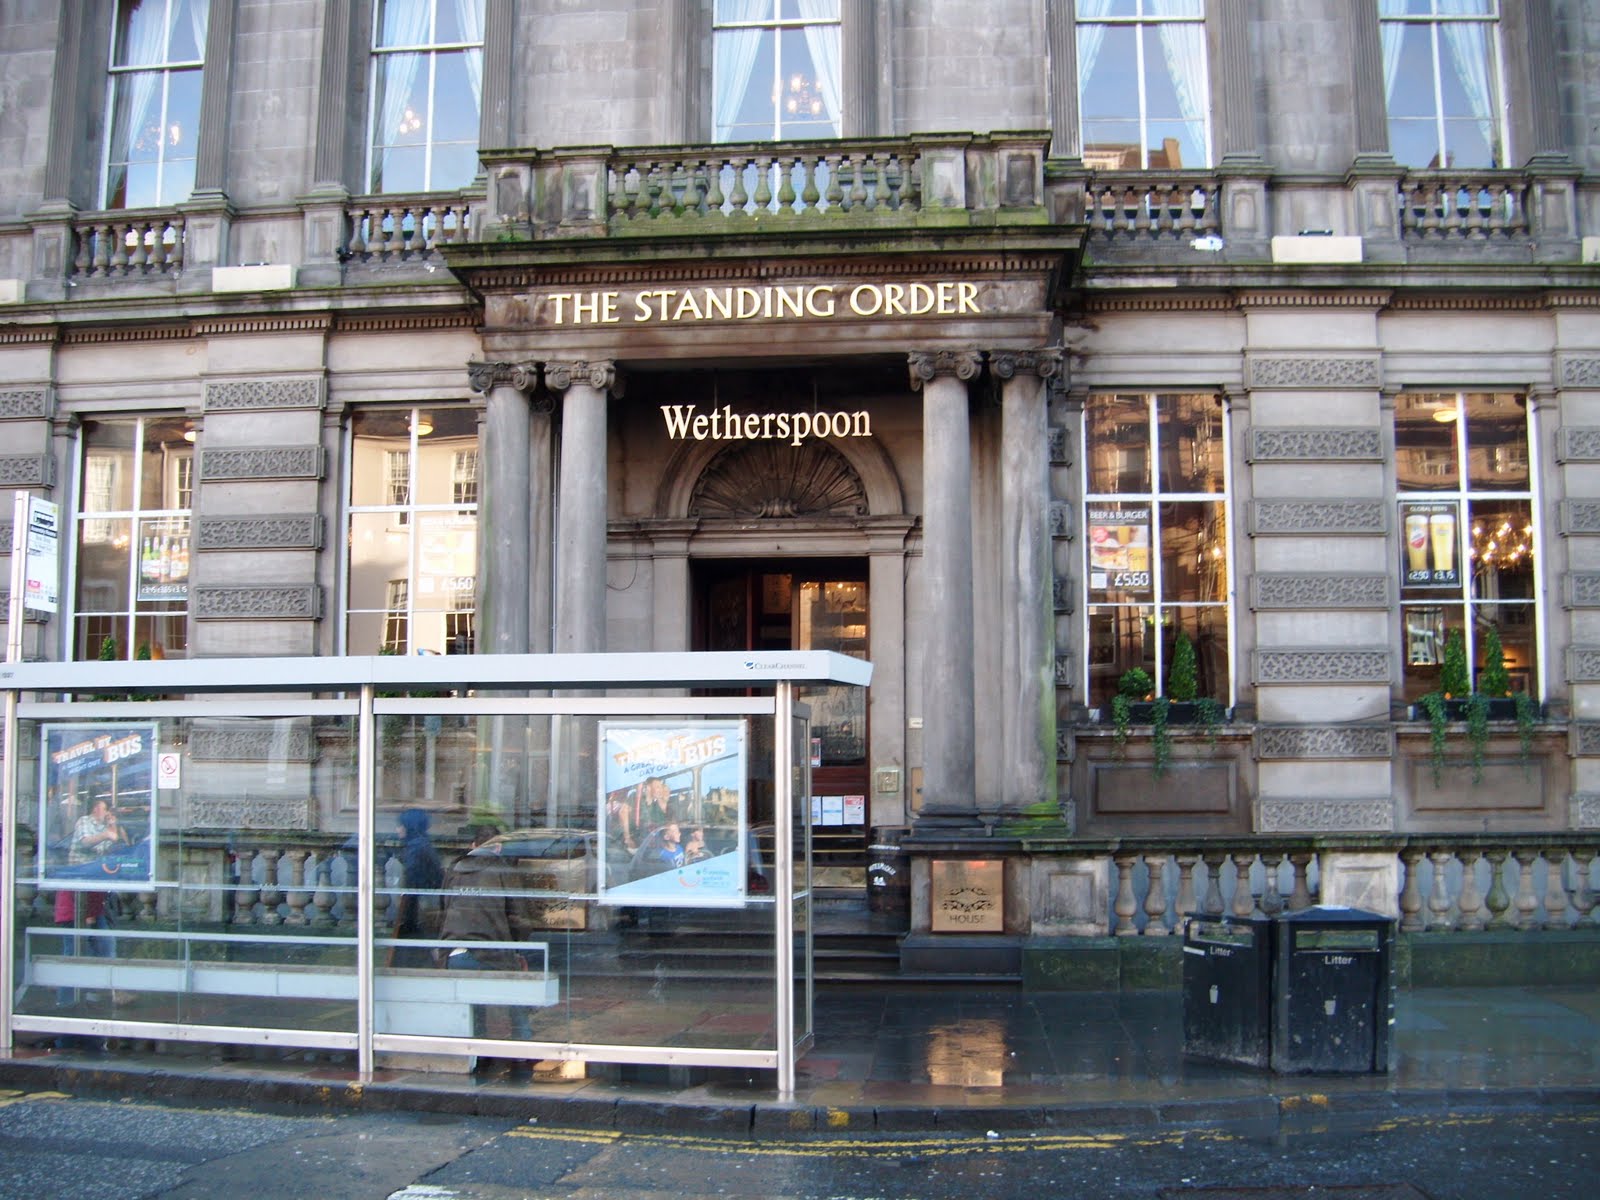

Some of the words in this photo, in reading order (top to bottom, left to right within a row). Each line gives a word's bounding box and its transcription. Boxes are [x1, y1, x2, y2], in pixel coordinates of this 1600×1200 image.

[547, 291, 620, 324] THE
[634, 285, 835, 321] STANDING
[850, 282, 981, 316] ORDER
[660, 404, 873, 447] Wetherspoon
[1090, 510, 1108, 519] BEER
[1109, 511, 1115, 519] &
[1116, 510, 1148, 519] BURGER
[1114, 572, 1149, 587] £5.60
[52, 741, 96, 764] TRAVEL
[95, 734, 111, 749] BY
[104, 733, 143, 764] BUS
[680, 734, 727, 764] BUS
[639, 766, 655, 778] DAY
[1209, 945, 1232, 957] Litter
[1324, 954, 1353, 965] Litter
